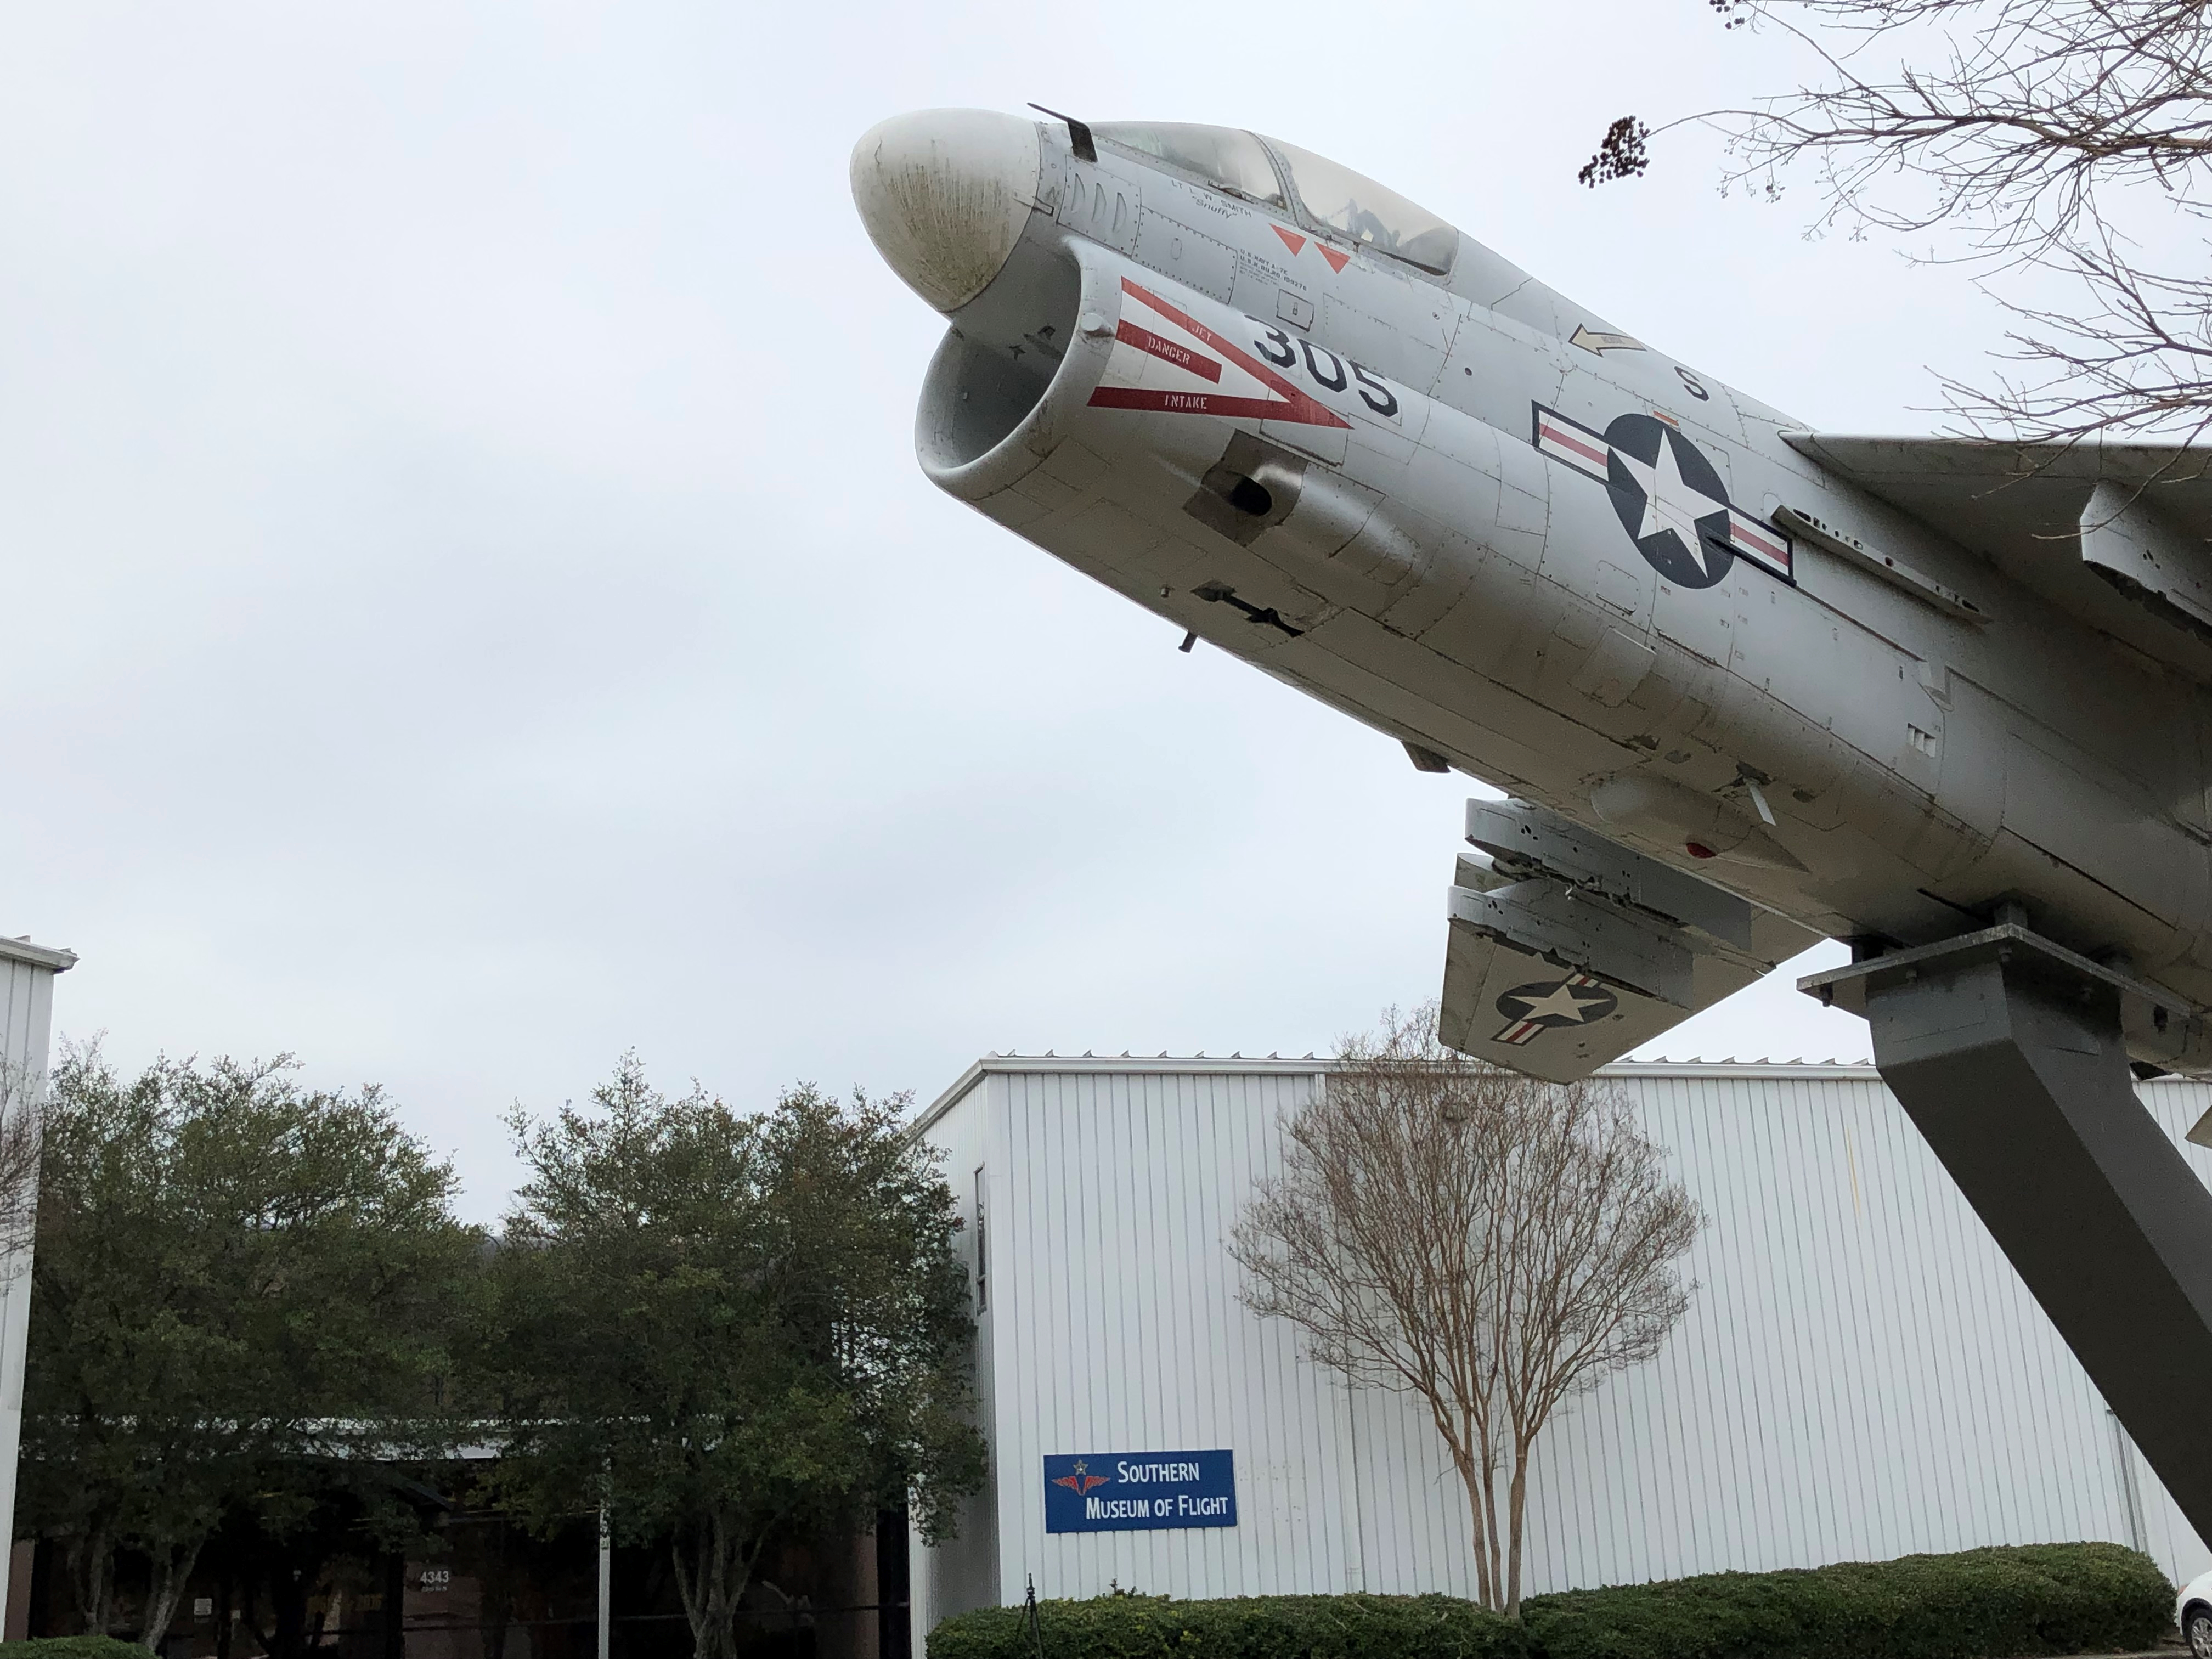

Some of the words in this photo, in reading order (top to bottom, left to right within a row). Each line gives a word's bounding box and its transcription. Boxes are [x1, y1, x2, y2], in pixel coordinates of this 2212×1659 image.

[1220, 199, 1252, 218] SMITH
[1192, 323, 1211, 342] JET
[1148, 335, 1191, 365] DANGER
[1244, 314, 1400, 417] 305
[1674, 366, 1709, 402] S
[1165, 394, 1207, 410] INTAKE
[1117, 1461, 1200, 1483] SOUTHERN
[1085, 1497, 1150, 1519] MUSEUM
[1154, 1499, 1174, 1517] OF
[1179, 1494, 1229, 1516] FLIGHT
[420, 1570, 449, 1584] 4343
